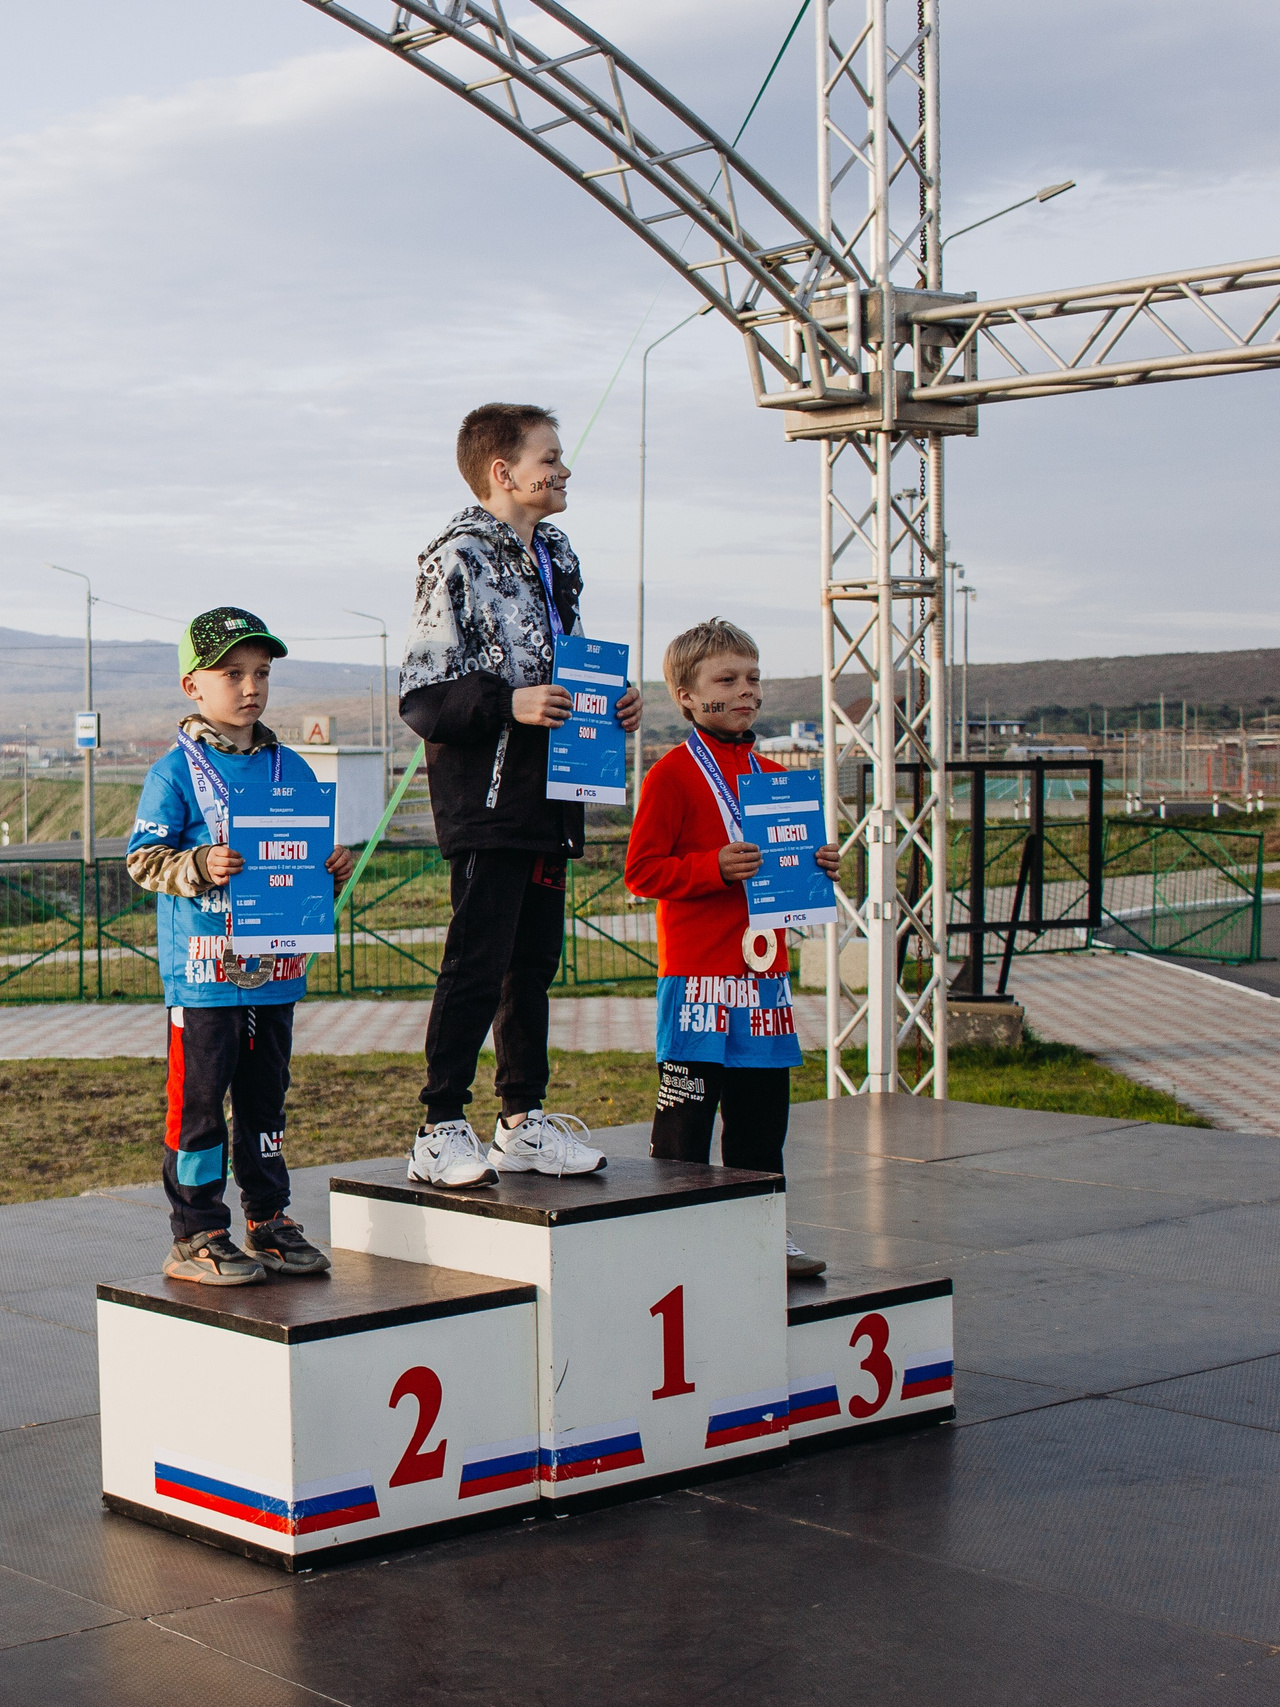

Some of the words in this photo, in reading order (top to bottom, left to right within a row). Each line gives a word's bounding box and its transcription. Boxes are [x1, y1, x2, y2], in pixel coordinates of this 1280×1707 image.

[579, 693, 608, 715] МЕСТО
[579, 726, 590, 739] 500
[696, 745, 716, 773] ОБЛАСТЬ
[196, 773, 207, 793] ПСБ
[584, 789, 596, 797] ПСБ
[134, 818, 169, 838] ПСБ
[777, 824, 808, 843] МЕСТО
[268, 840, 308, 860] МЕСТО
[779, 856, 792, 867] 500
[269, 874, 285, 887] 500
[285, 874, 294, 887] М
[793, 914, 806, 922] ПСБ
[280, 940, 297, 948] ПСБ
[649, 1285, 695, 1400] 1
[848, 1313, 893, 1419] 3
[389, 1366, 448, 1488] 2
